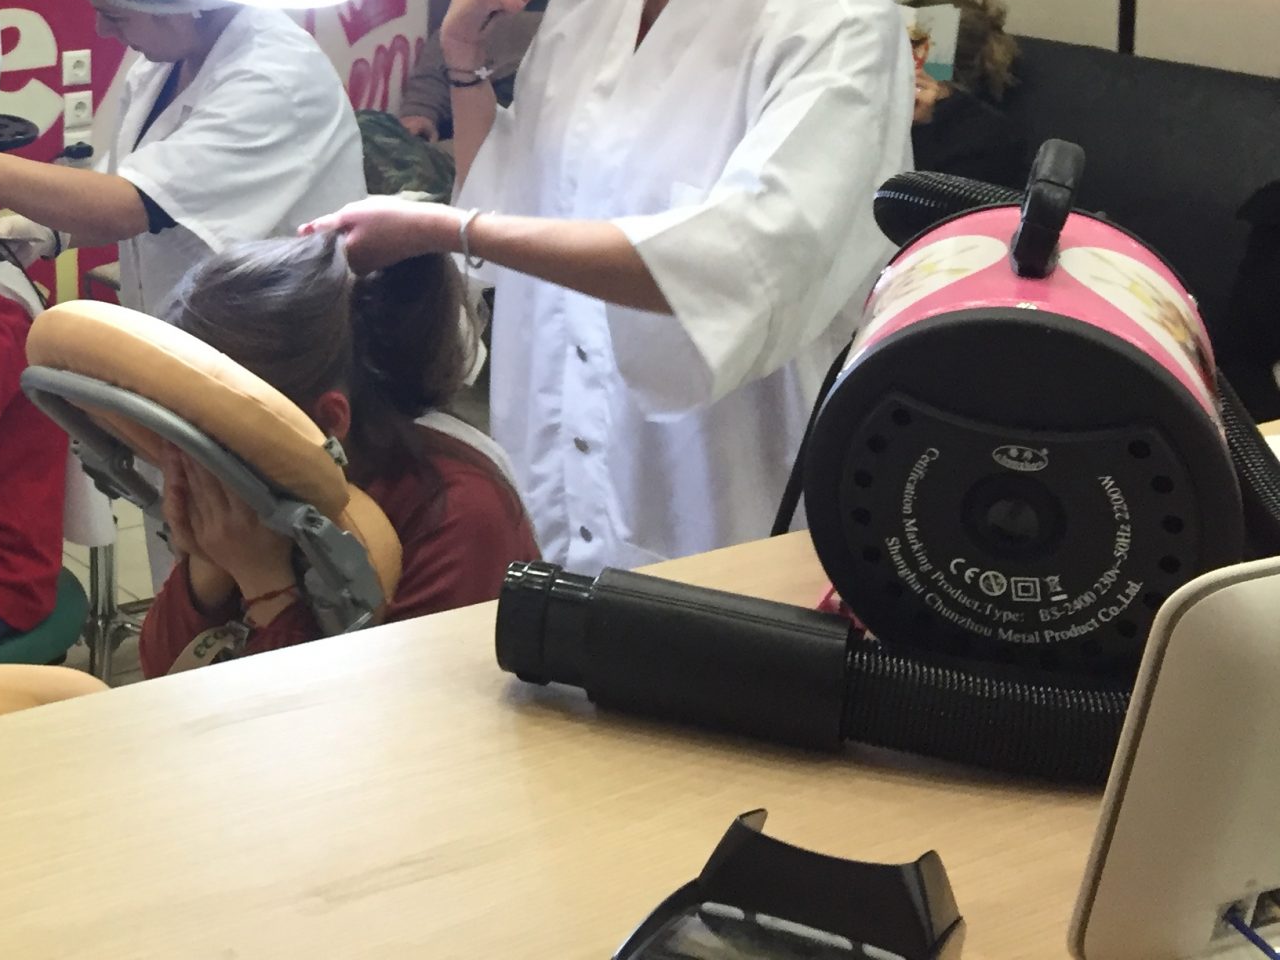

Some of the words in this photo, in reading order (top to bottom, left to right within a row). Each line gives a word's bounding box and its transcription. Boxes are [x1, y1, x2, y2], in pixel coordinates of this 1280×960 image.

[903, 518, 933, 572] Marking
[1098, 476, 1130, 521] 2200W
[885, 537, 925, 594] Shanghai
[999, 628, 1040, 644] Metal
[1044, 619, 1100, 643] Product
